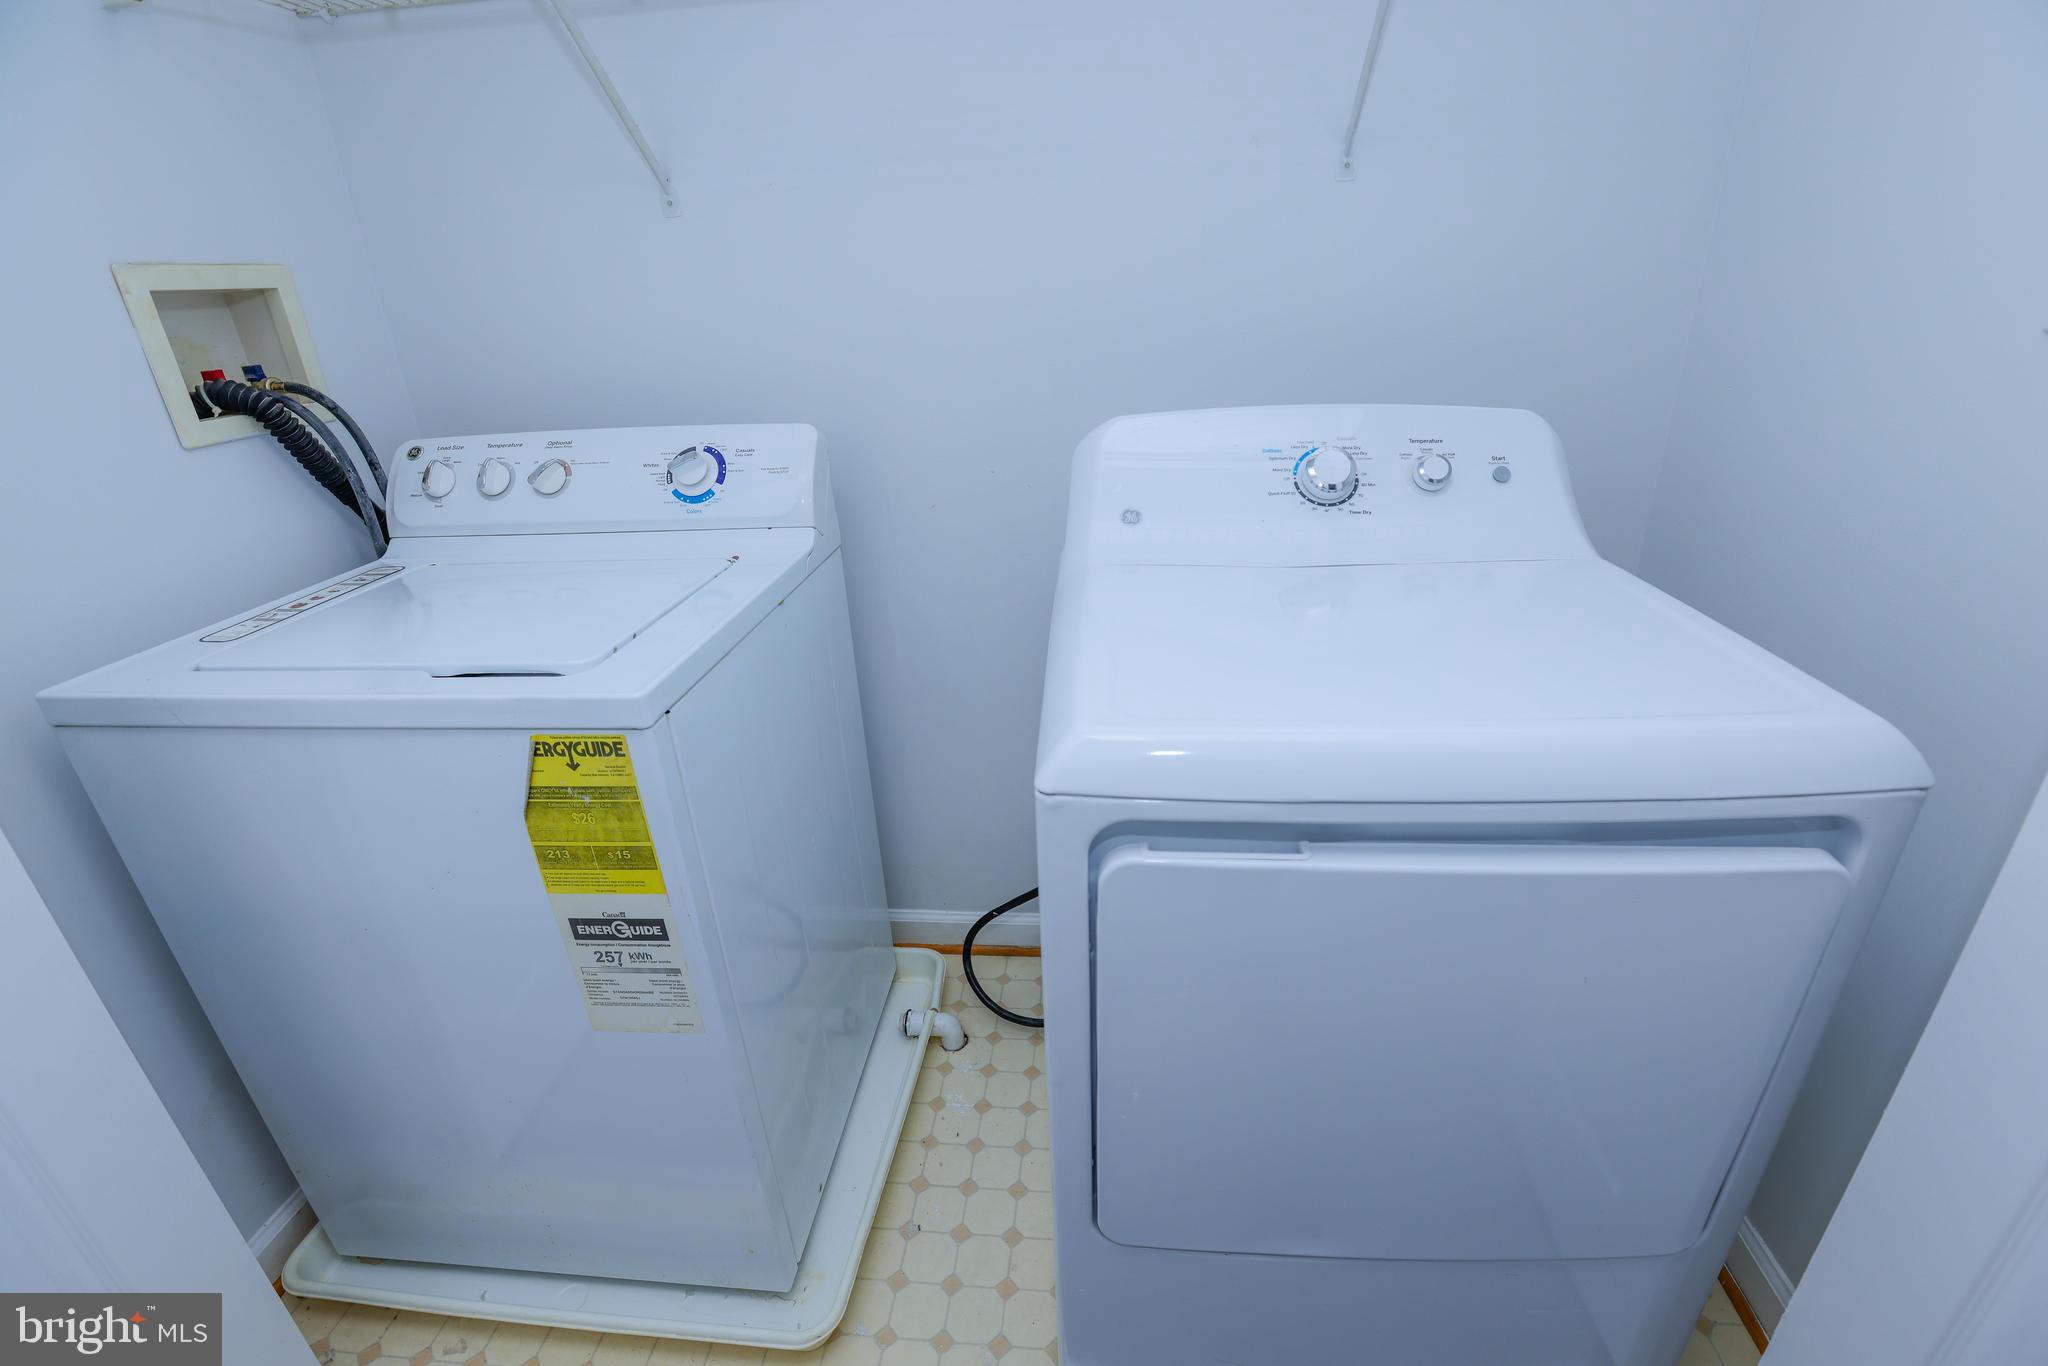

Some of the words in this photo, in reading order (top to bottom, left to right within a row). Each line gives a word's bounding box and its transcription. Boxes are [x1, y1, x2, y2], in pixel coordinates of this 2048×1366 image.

[571, 812, 596, 825] $26
[547, 850, 570, 859] 213
[607, 850, 631, 859] $15
[576, 920, 663, 938] ENERGUIDE
[593, 950, 623, 963] 257
[628, 952, 653, 960] kWh
